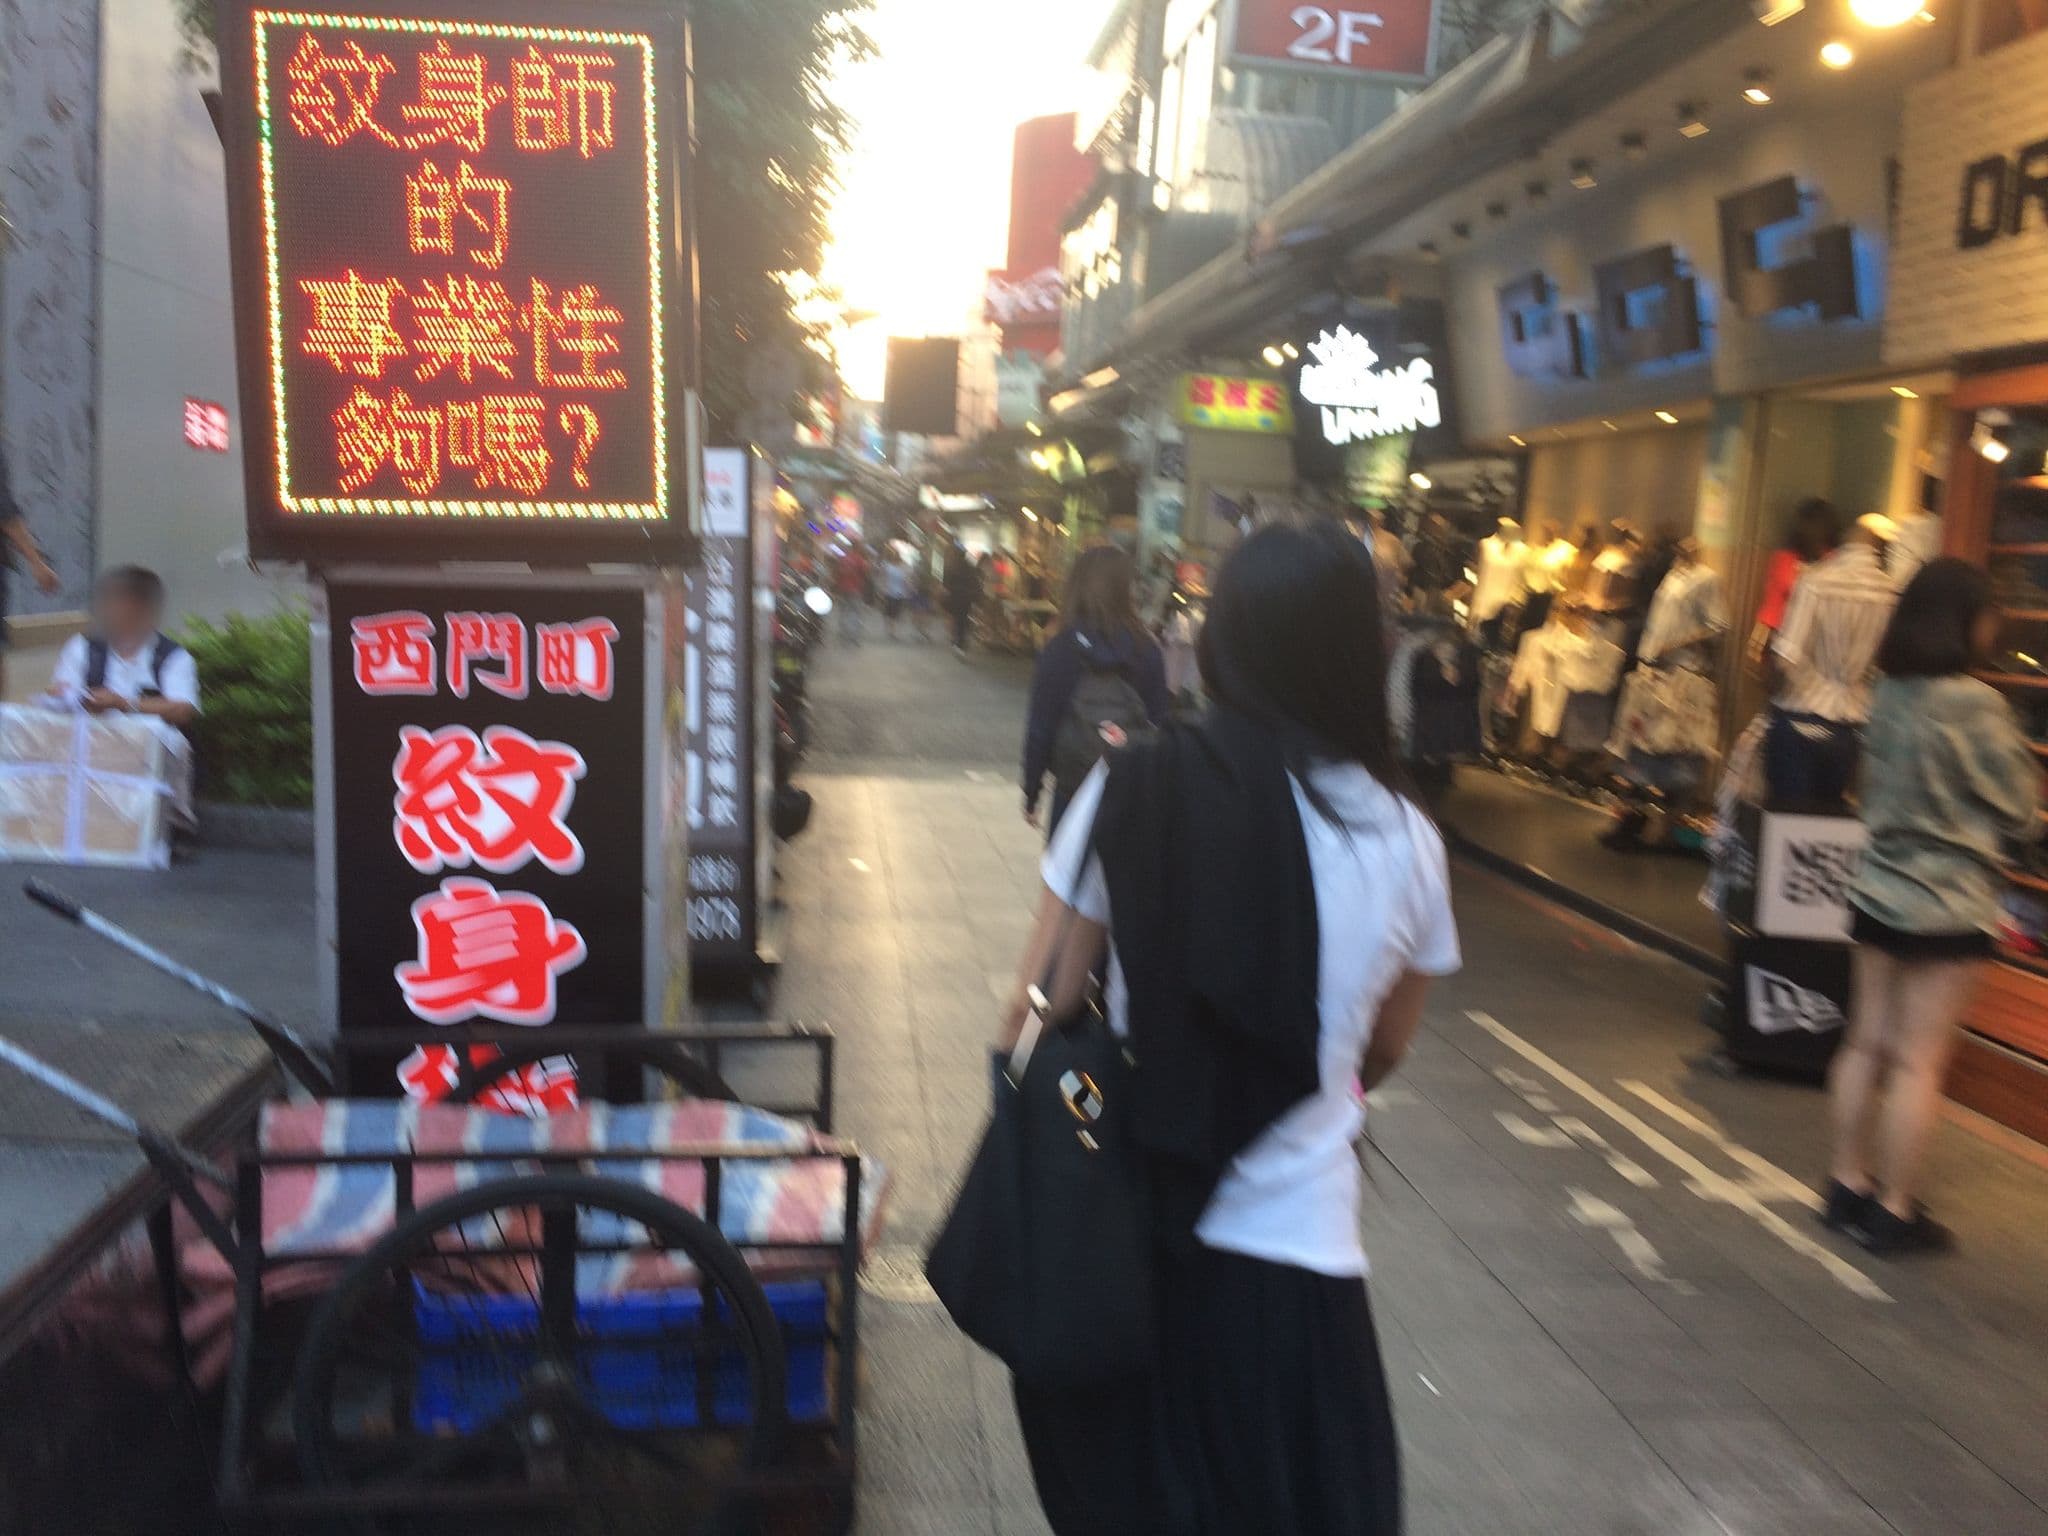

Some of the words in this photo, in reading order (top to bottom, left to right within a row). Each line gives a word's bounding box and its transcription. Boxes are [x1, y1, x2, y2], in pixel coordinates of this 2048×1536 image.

[1286, 5, 1384, 65] 2F
[288, 32, 616, 158] 紋身師
[405, 158, 512, 270] 的
[300, 268, 628, 389] 專業性
[350, 610, 620, 701] 西門町
